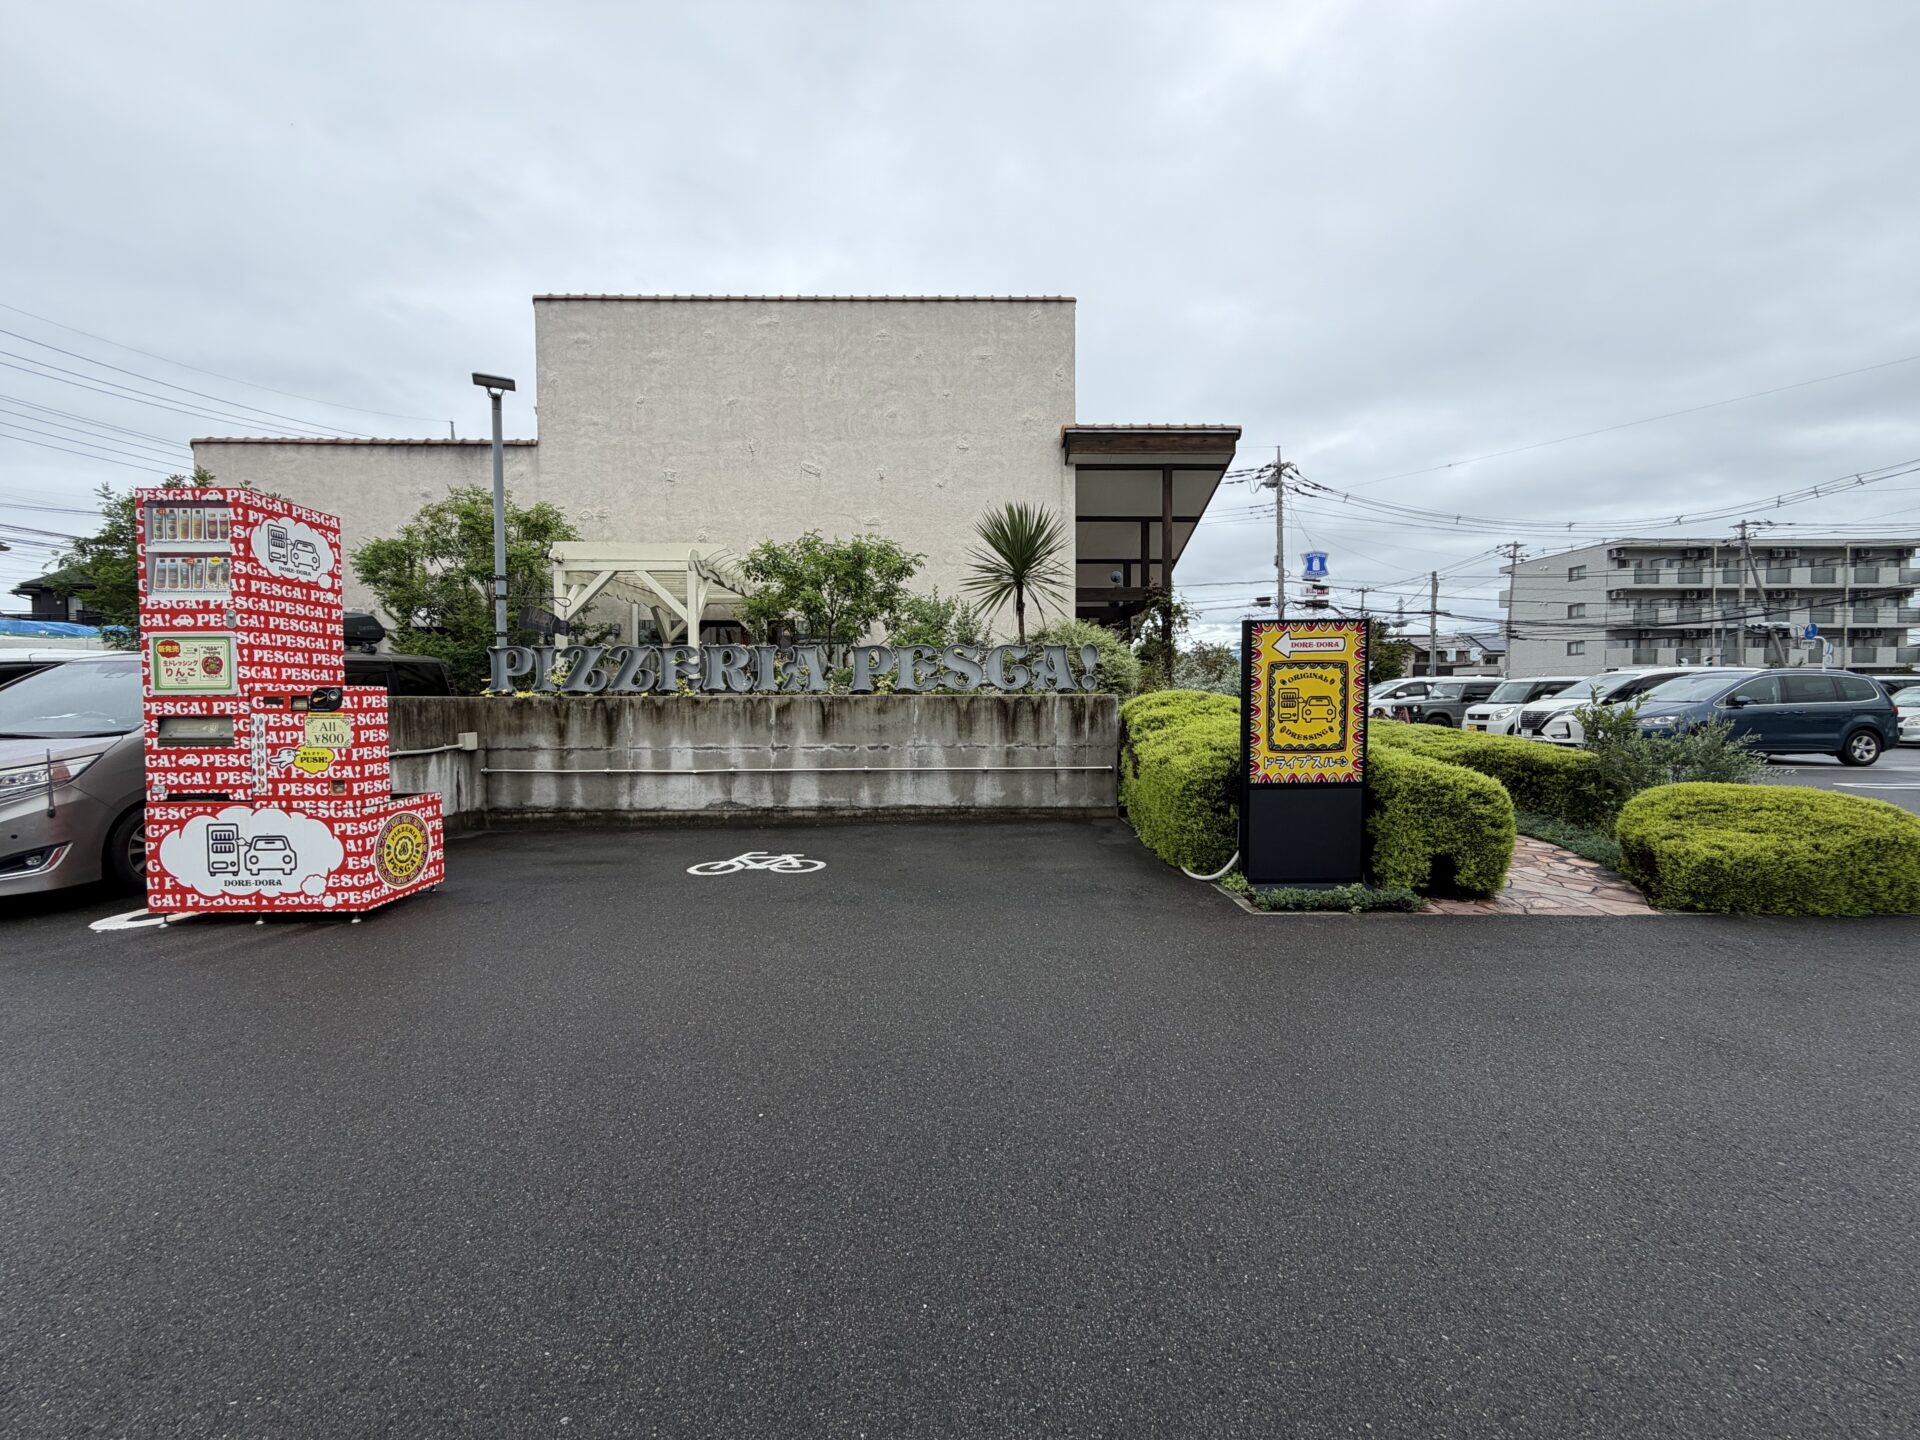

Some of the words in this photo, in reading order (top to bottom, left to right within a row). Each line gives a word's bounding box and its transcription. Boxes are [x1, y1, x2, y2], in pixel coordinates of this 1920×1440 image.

[226, 489, 288, 514] PESCA!
[292, 505, 341, 529] PESCA
[250, 580, 307, 600] PESCA!
[275, 601, 329, 619] PESCA!
[269, 616, 323, 634] PESCA!
[276, 634, 329, 650] PESCA!
[253, 649, 309, 664] PESCA!
[165, 668, 196, 677] りんご
[281, 667, 334, 681] PESCA!
[487, 644, 828, 692] PIZZERIA
[850, 643, 1098, 692] PESCA!
[1287, 672, 1329, 684] ORIGINAL
[319, 722, 336, 731] All
[314, 733, 344, 744] ¥800
[1285, 728, 1329, 741] DRESSING
[391, 826, 418, 841] PIZZERIA
[224, 879, 282, 887] DORE-DORA
